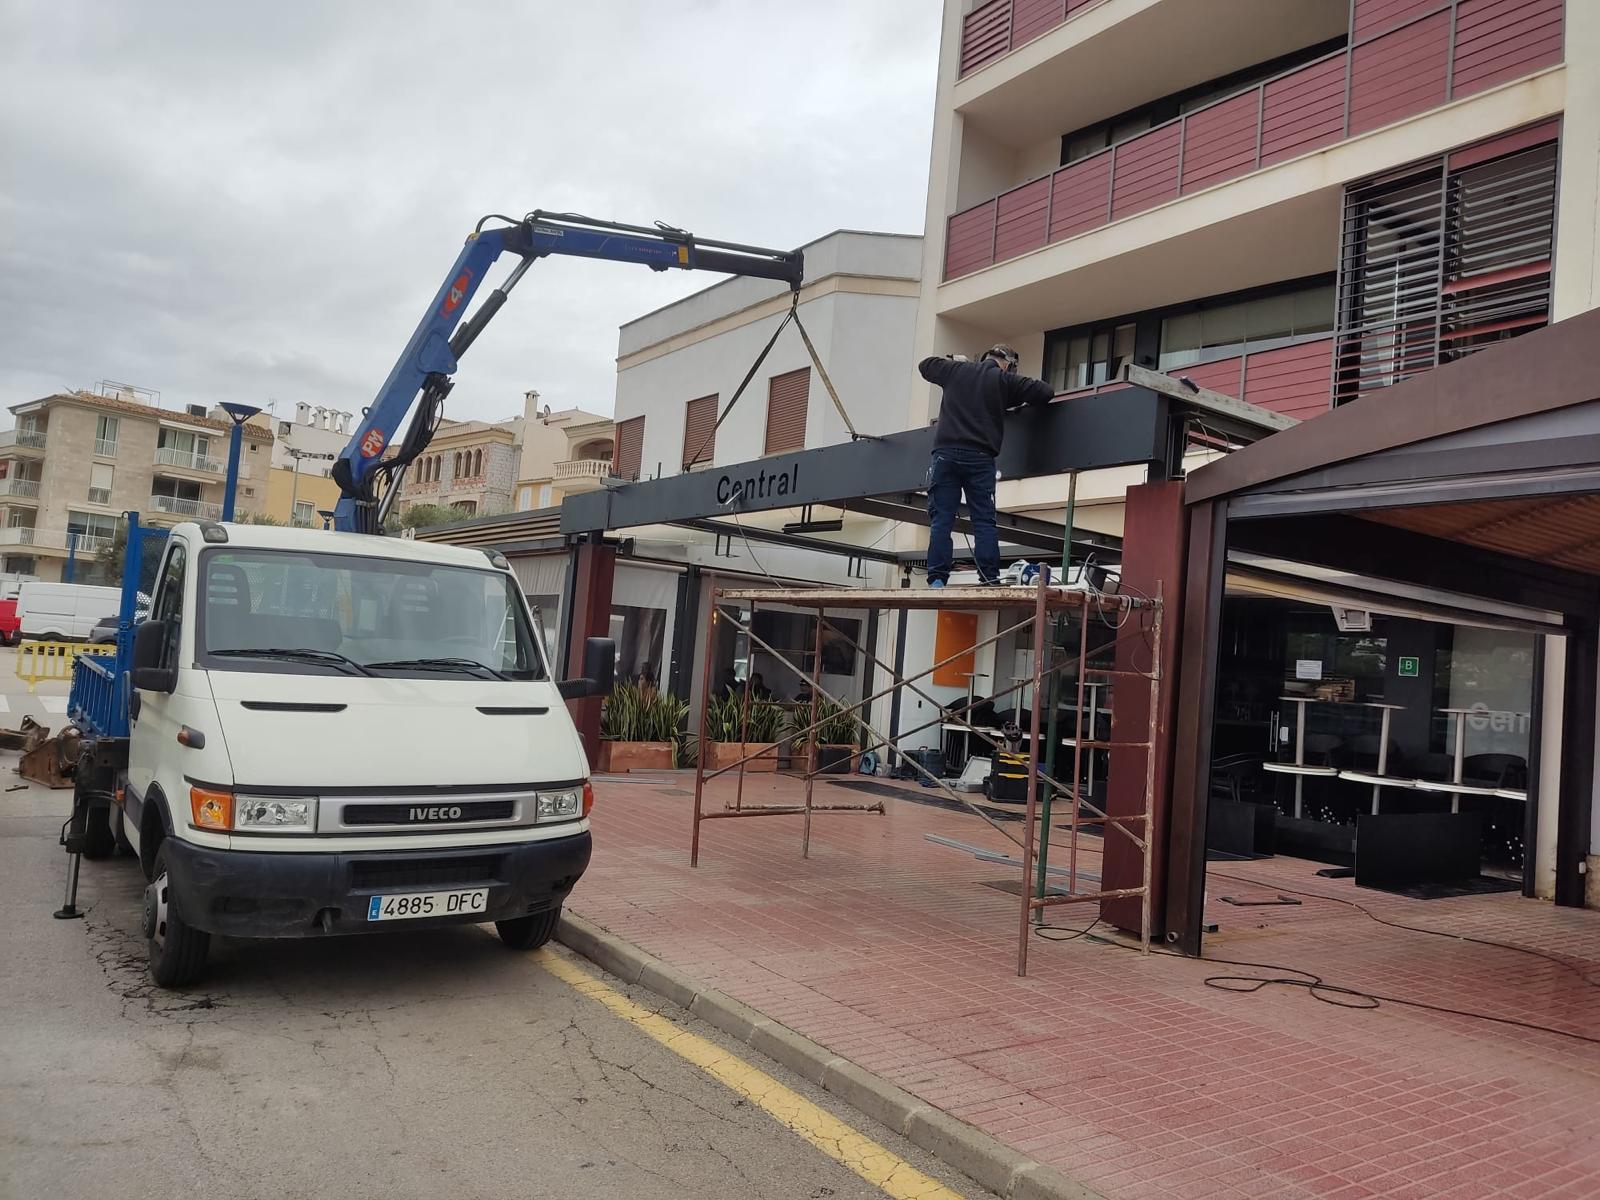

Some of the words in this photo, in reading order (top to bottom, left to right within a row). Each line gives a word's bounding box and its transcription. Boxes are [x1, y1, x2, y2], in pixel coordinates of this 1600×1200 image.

[451, 286, 463, 304] 4
[362, 430, 384, 457] PM
[717, 463, 798, 504] Central
[410, 806, 461, 820] IVECO
[384, 896, 434, 916] 4885
[447, 892, 482, 912] DFC
